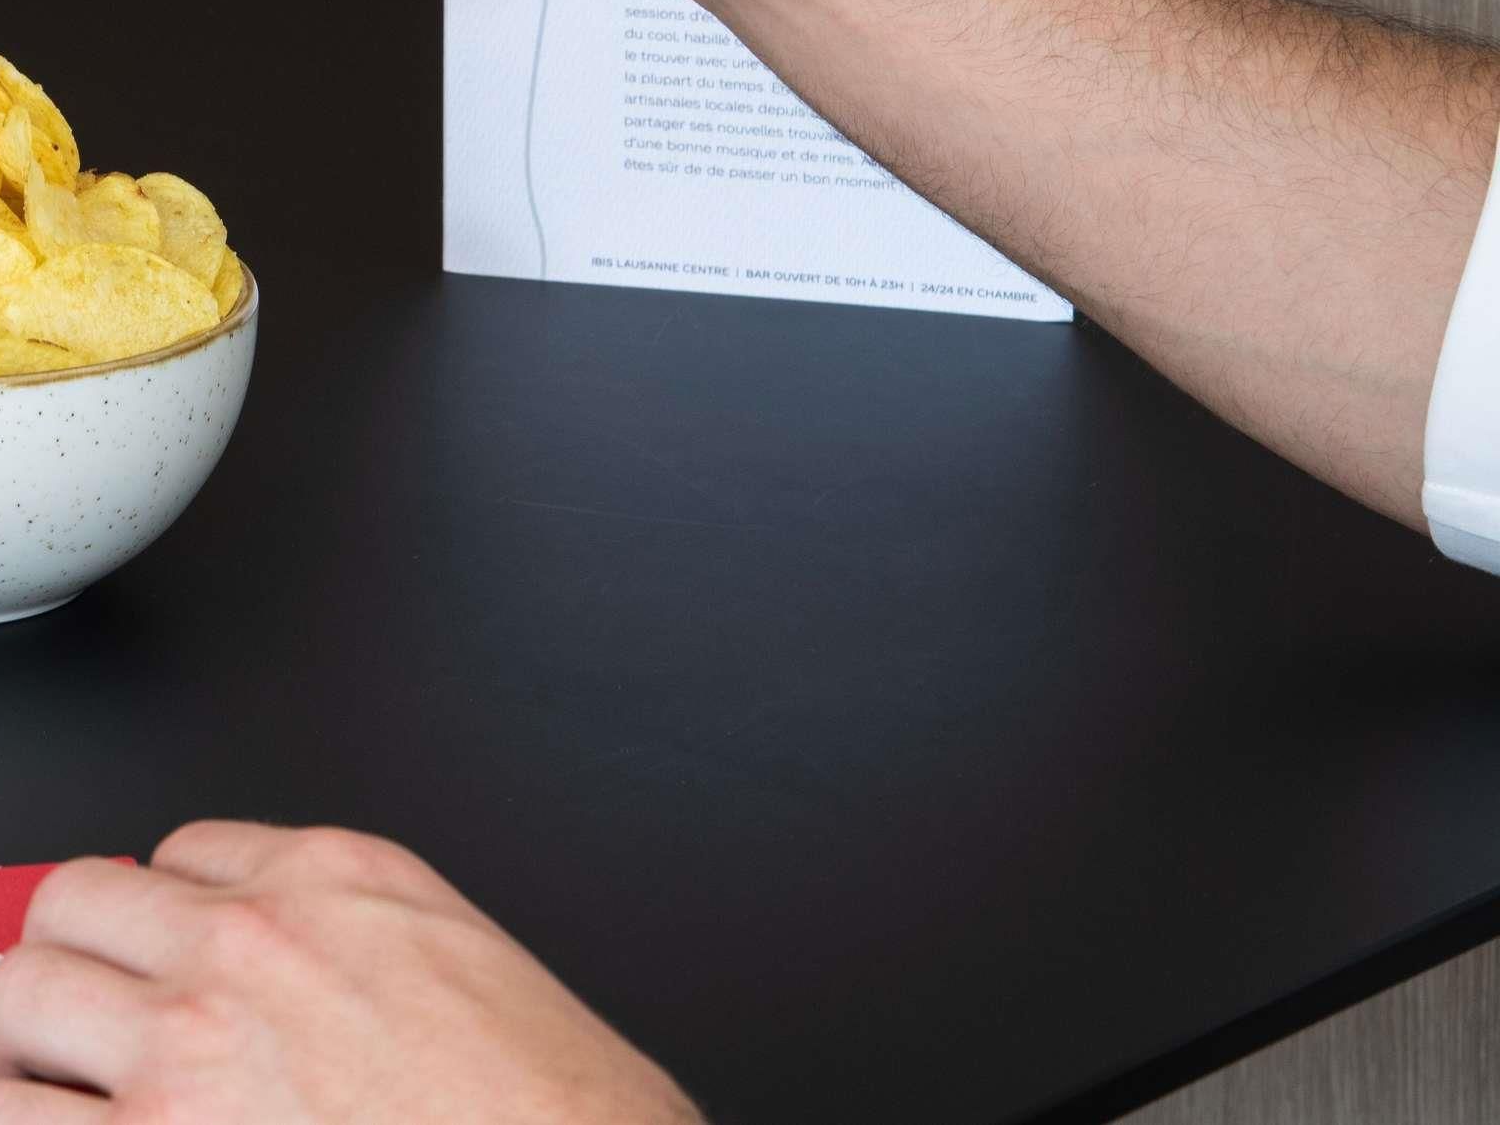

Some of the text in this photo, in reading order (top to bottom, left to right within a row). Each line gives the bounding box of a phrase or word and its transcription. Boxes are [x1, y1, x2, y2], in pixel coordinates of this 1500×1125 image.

[625, 7, 685, 21] sessions
[624, 27, 643, 40] du
[684, 32, 730, 46] habillé
[624, 50, 636, 62] le
[641, 51, 691, 64] trouver
[695, 56, 728, 68] avec
[732, 59, 759, 71] une
[624, 72, 636, 84] la
[641, 73, 692, 88] plupart
[696, 77, 715, 89] du
[624, 94, 701, 109] artisanales
[705, 99, 754, 114] locales
[757, 104, 806, 118] depuis
[624, 116, 685, 131] partager
[690, 121, 713, 133] ses
[717, 123, 784, 139] nouvelles
[624, 137, 663, 150] d'une
[667, 140, 712, 154] bonne
[716, 144, 777, 160] musique
[781, 150, 796, 161] et
[800, 151, 819, 163] de
[624, 158, 653, 172] êtes
[658, 160, 679, 173] sûr
[684, 162, 702, 175] de
[706, 164, 725, 177] de
[729, 168, 776, 181] passer
[780, 172, 798, 183] un
[803, 172, 831, 186] bon
[835, 177, 897, 191] moment
[591, 257, 614, 268] IBIS
[616, 259, 678, 273] LAUSANNE
[682, 263, 730, 277] CENTRE
[746, 269, 771, 280] BAR
[775, 271, 820, 284] OUVERT
[824, 276, 841, 287] DE
[845, 277, 866, 287] 10H
[881, 279, 904, 291] 23H
[920, 283, 954, 295] 24/24
[957, 286, 973, 297] EN
[976, 288, 1038, 303] CHAMBRE
